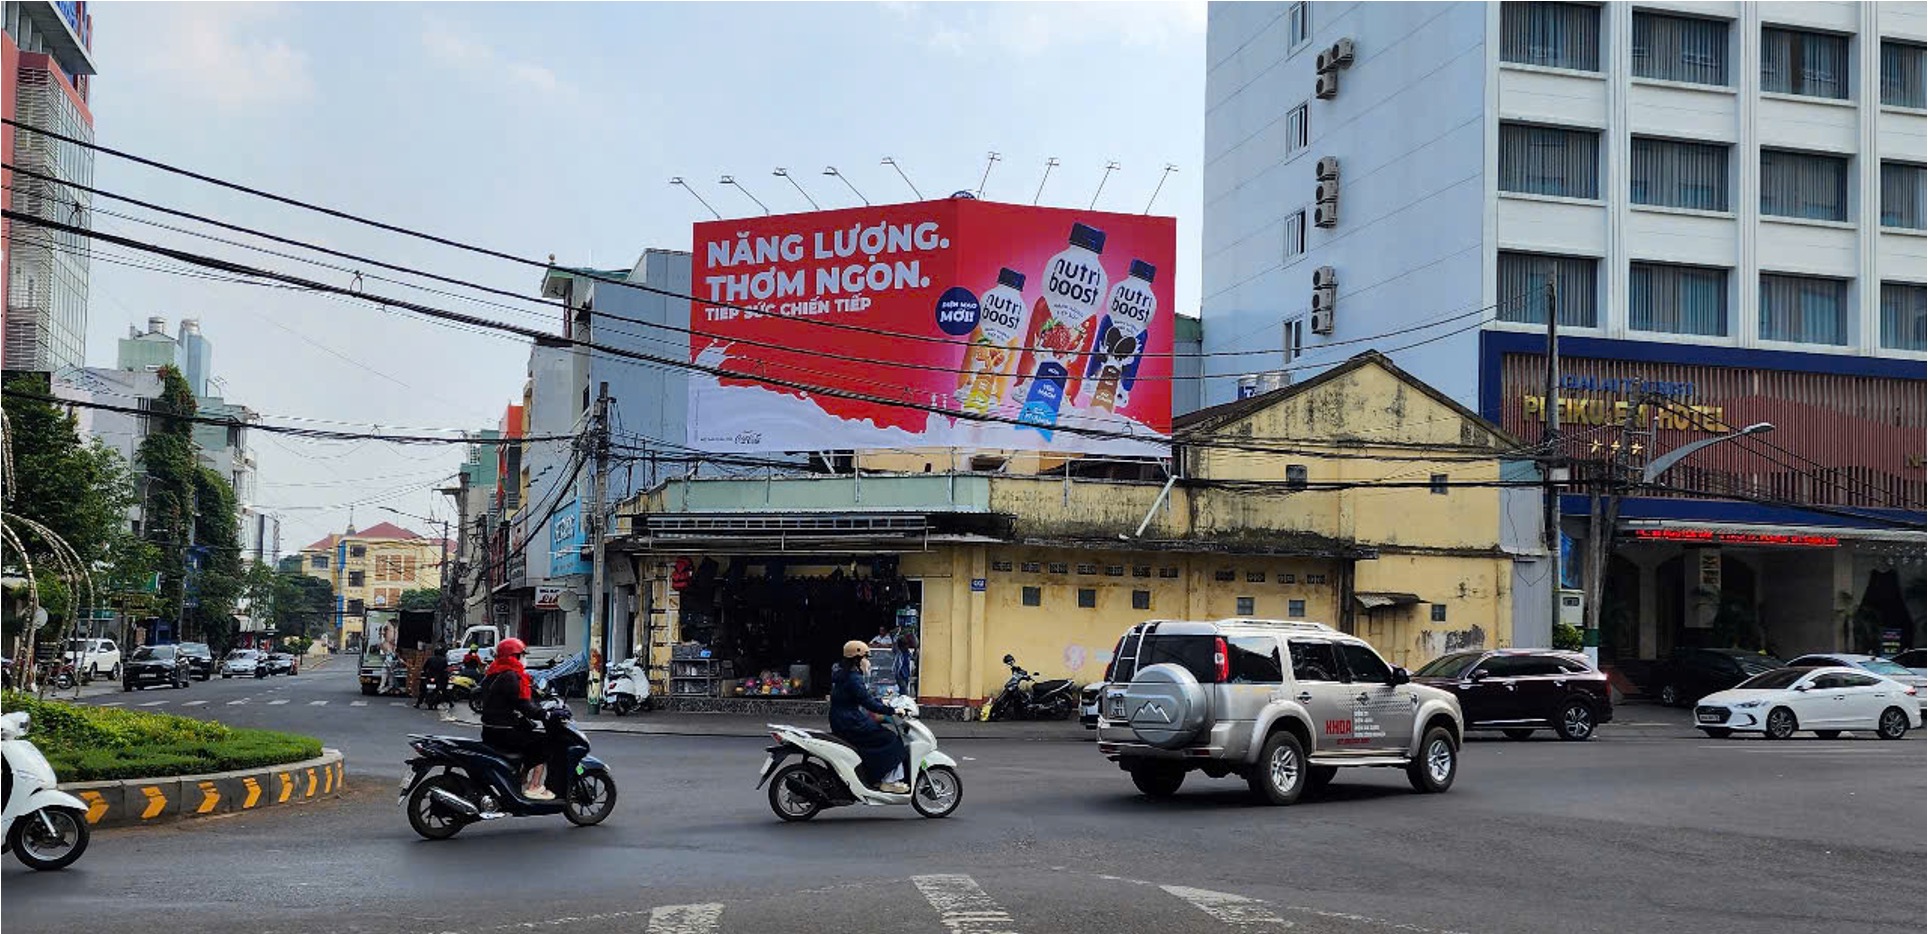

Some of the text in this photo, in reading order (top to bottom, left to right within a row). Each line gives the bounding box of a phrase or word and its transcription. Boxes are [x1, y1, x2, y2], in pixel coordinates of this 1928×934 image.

[707, 220, 950, 268] NĂNG LƯỢNG.
[705, 260, 931, 302] THƠM NGON.
[1054, 258, 1101, 286] nutri
[1049, 271, 1099, 306] boost
[1116, 285, 1153, 308] nutri
[780, 294, 830, 317] CHIẾN
[834, 292, 872, 314] TIẾP
[981, 304, 1021, 330] boost
[985, 293, 1022, 315] nutri
[1111, 296, 1150, 323] boost
[1658, 403, 1730, 433] HOTEL
